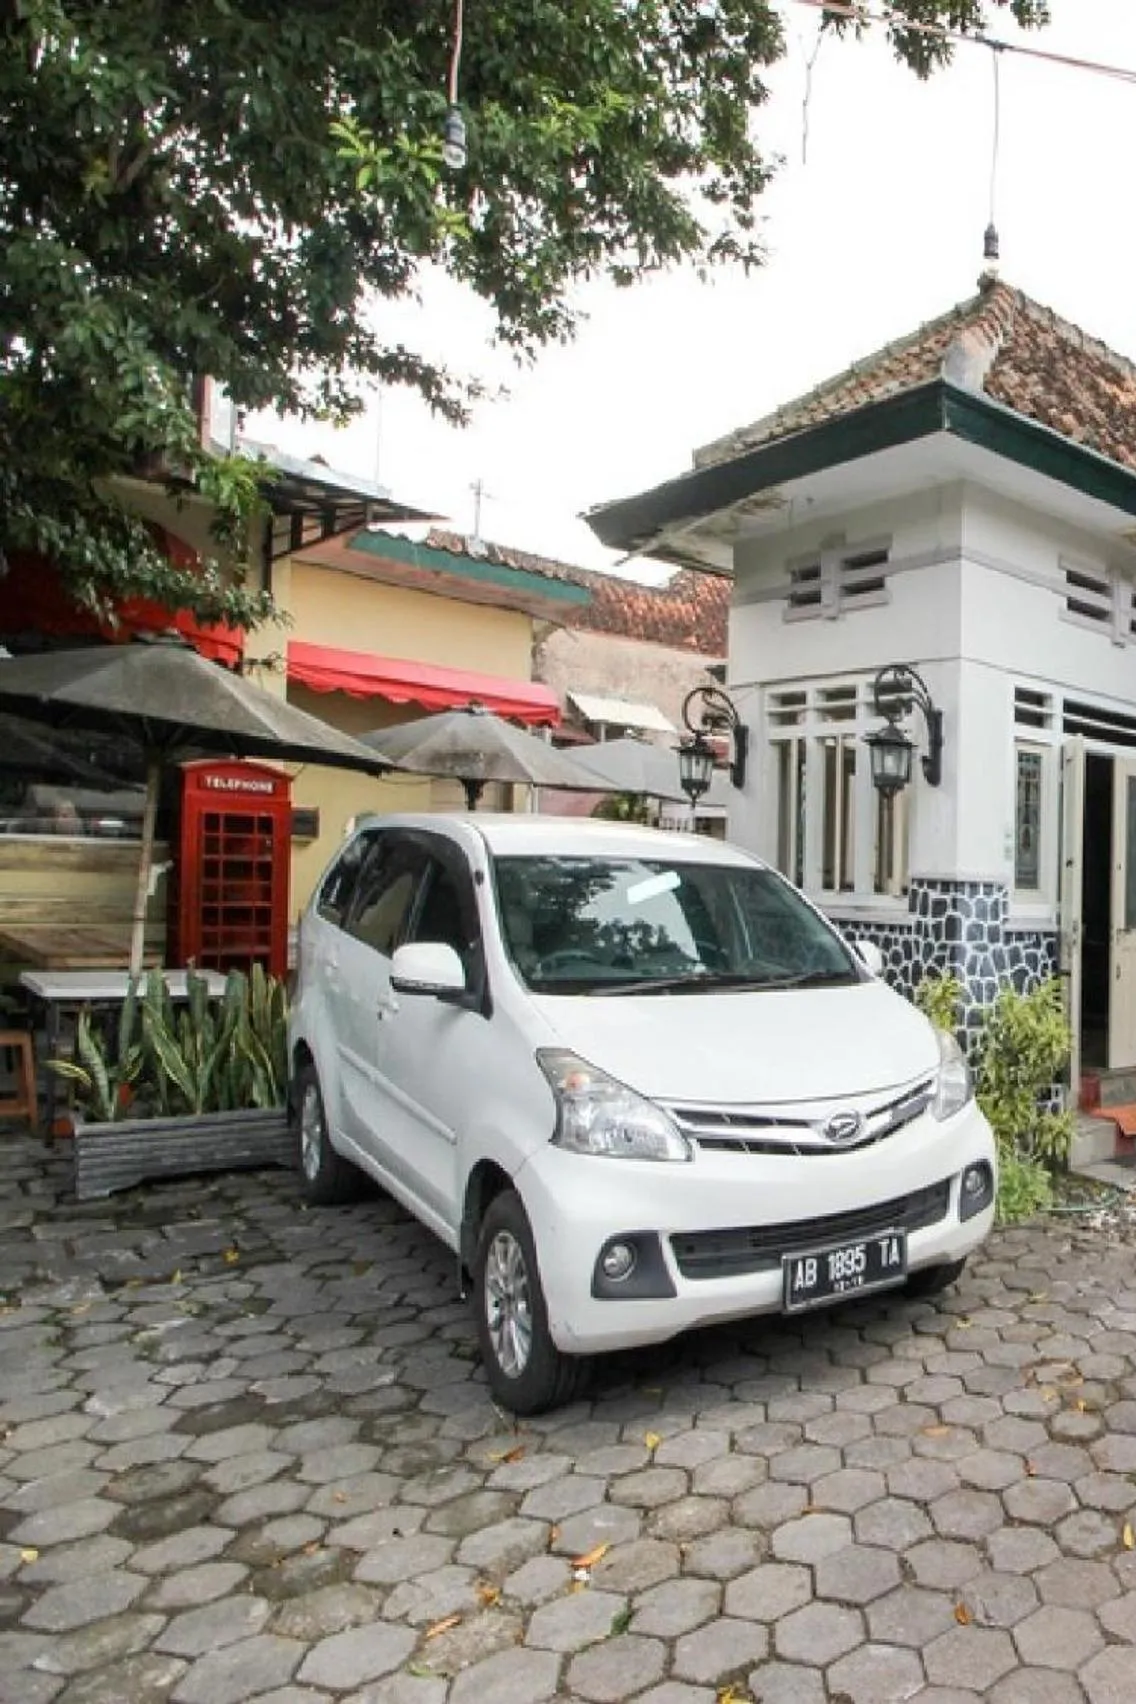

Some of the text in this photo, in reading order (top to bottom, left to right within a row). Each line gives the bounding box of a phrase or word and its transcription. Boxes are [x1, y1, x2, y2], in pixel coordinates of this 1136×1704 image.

[205, 775, 273, 794] TELEPHONE
[794, 1257, 817, 1291] AB
[878, 1237, 900, 1267] TA
